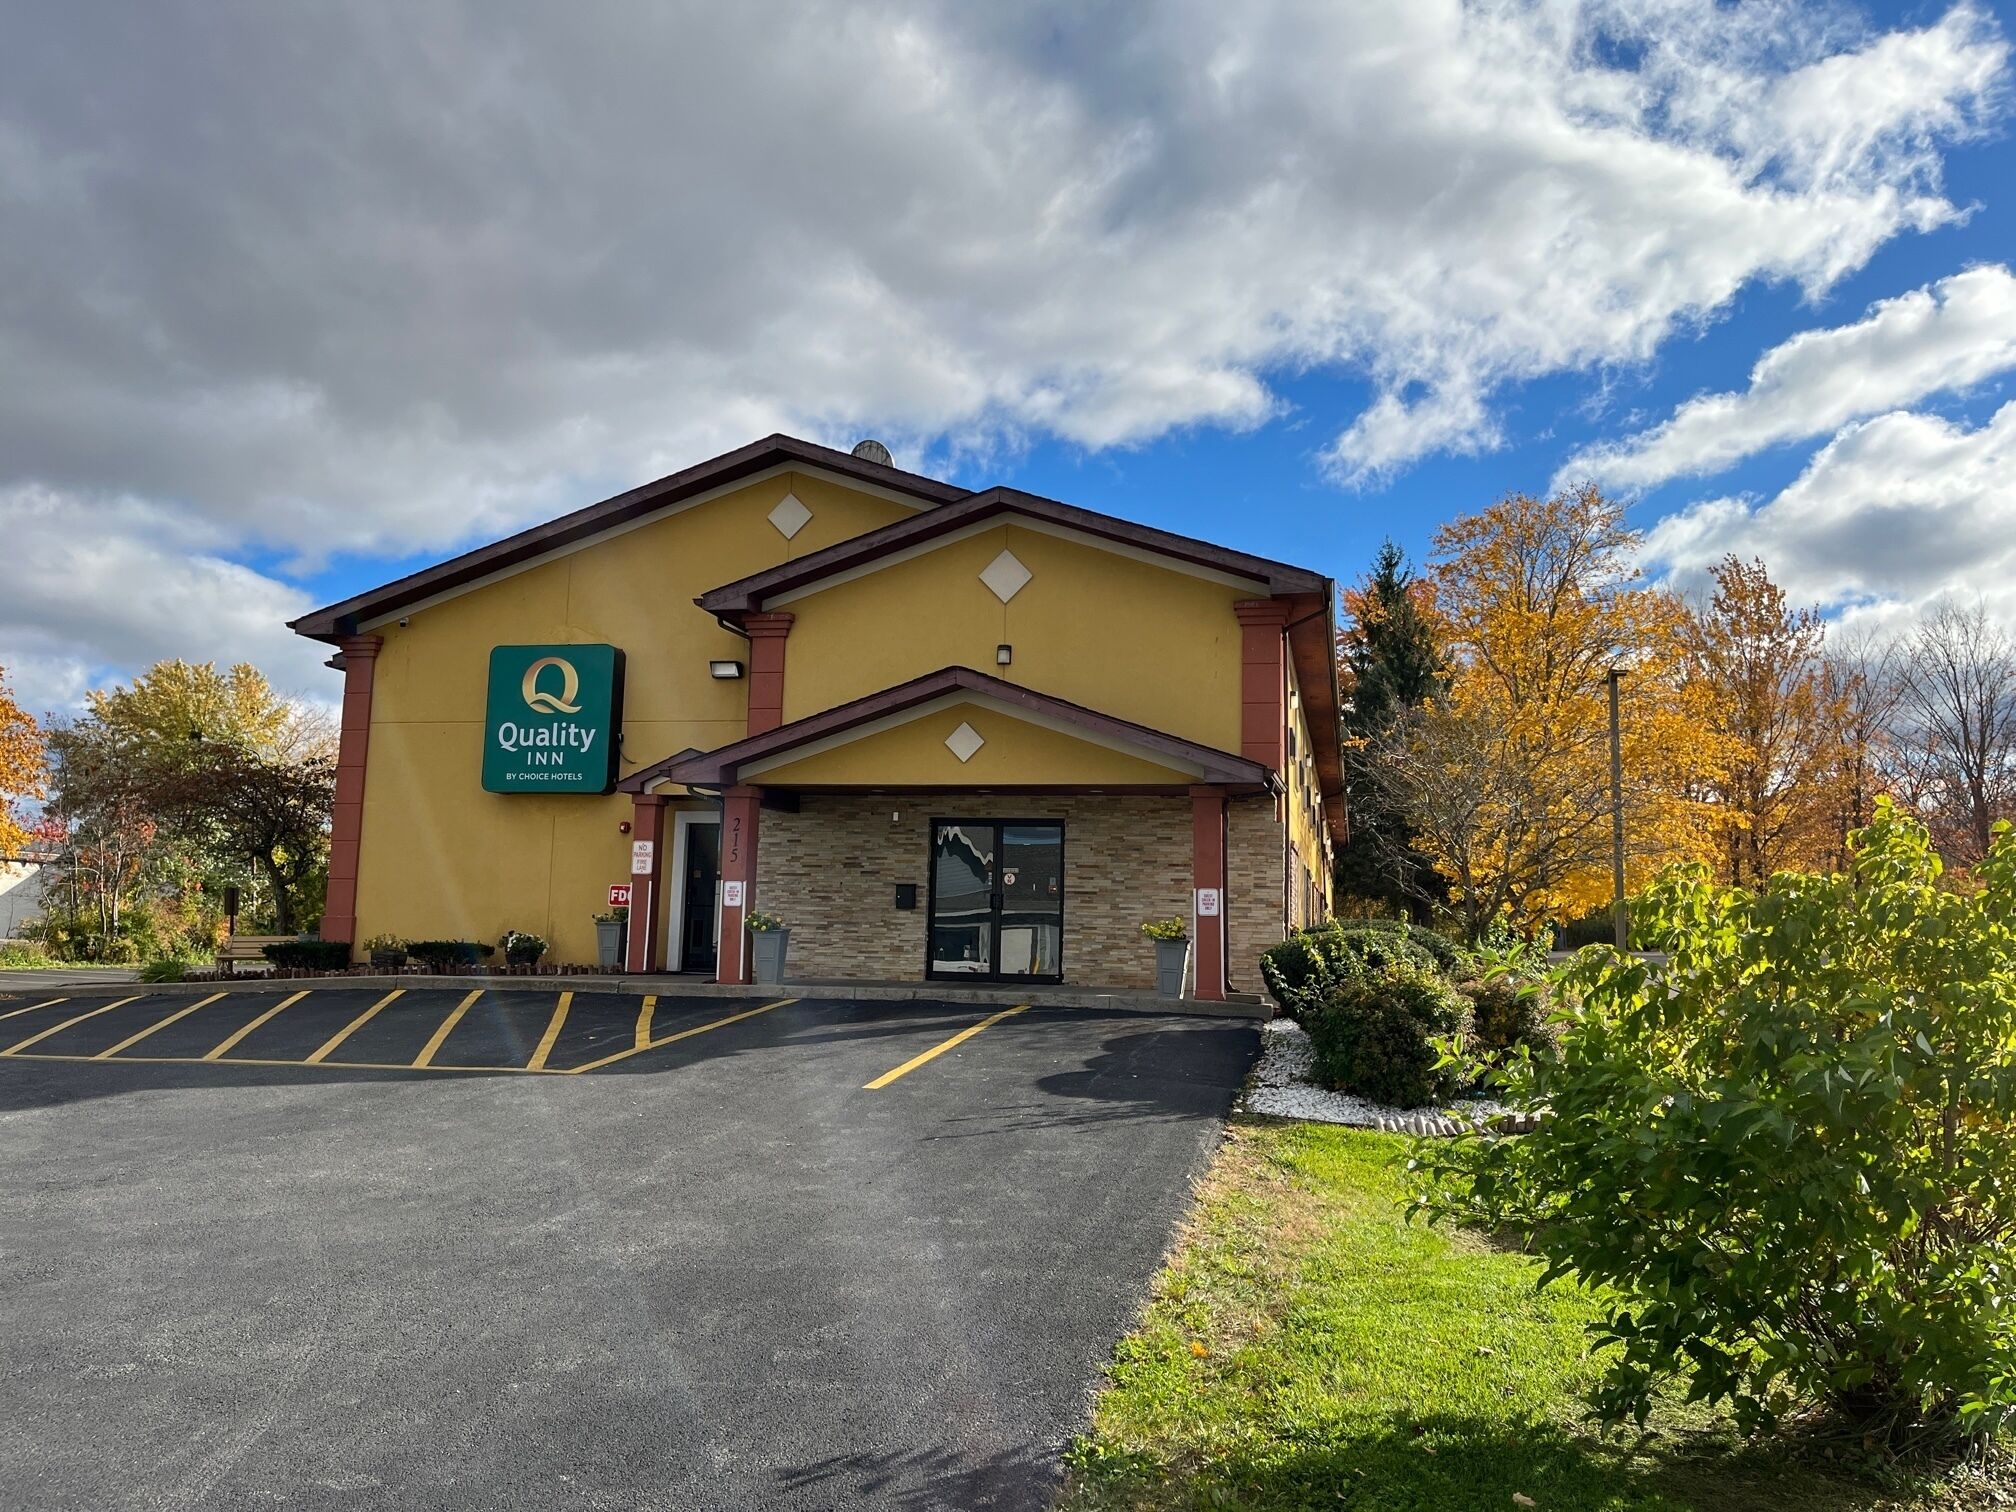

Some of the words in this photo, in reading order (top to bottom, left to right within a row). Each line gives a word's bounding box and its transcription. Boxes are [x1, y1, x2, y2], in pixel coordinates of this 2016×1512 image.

[522, 656, 582, 714] Q
[498, 722, 596, 753] Quality
[527, 751, 564, 765] INN
[518, 772, 549, 780] CHOICE
[551, 772, 583, 780] HOTELS
[730, 817, 740, 863] 215
